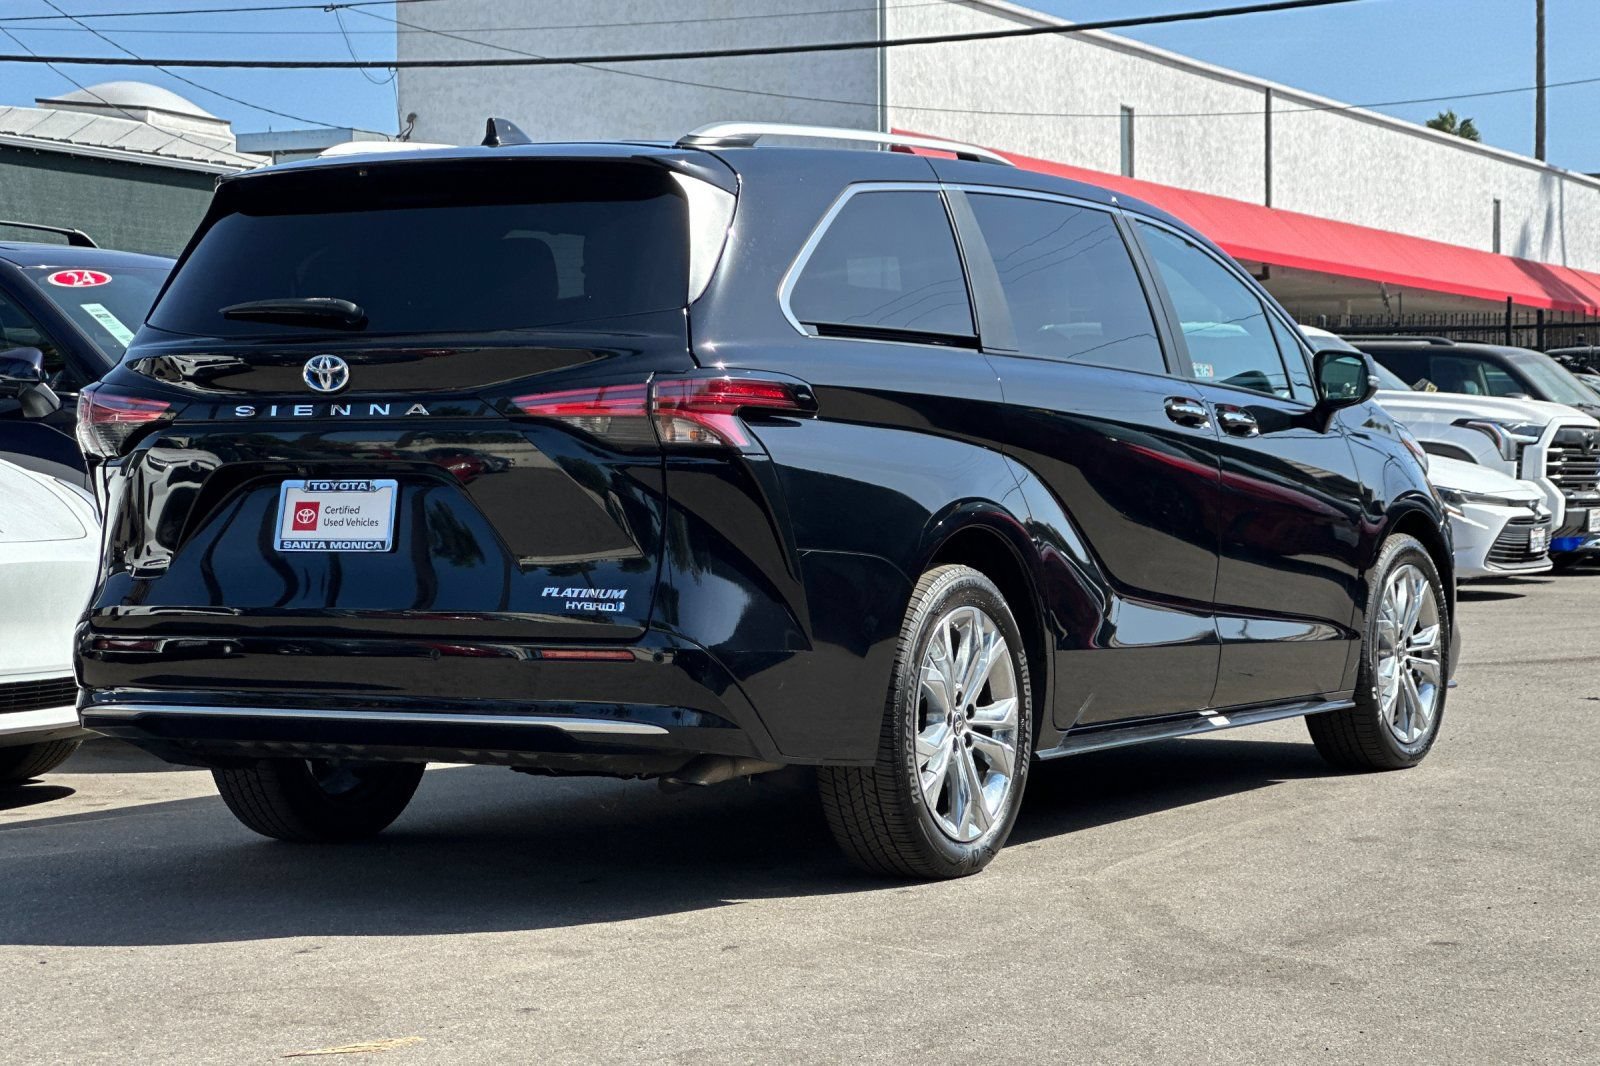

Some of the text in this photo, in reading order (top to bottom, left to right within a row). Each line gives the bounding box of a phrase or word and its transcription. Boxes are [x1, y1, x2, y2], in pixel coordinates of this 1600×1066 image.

[235, 403, 430, 417] SIENNA
[311, 481, 368, 491] TOYOTA
[324, 505, 361, 515] Certified
[323, 518, 379, 527] Used Vehicles
[283, 541, 383, 550] SANTA MONICA
[541, 587, 628, 599] PLATINUM
[565, 601, 615, 611] HYBRID
[1017, 650, 1032, 775] BRIDGESTONE
